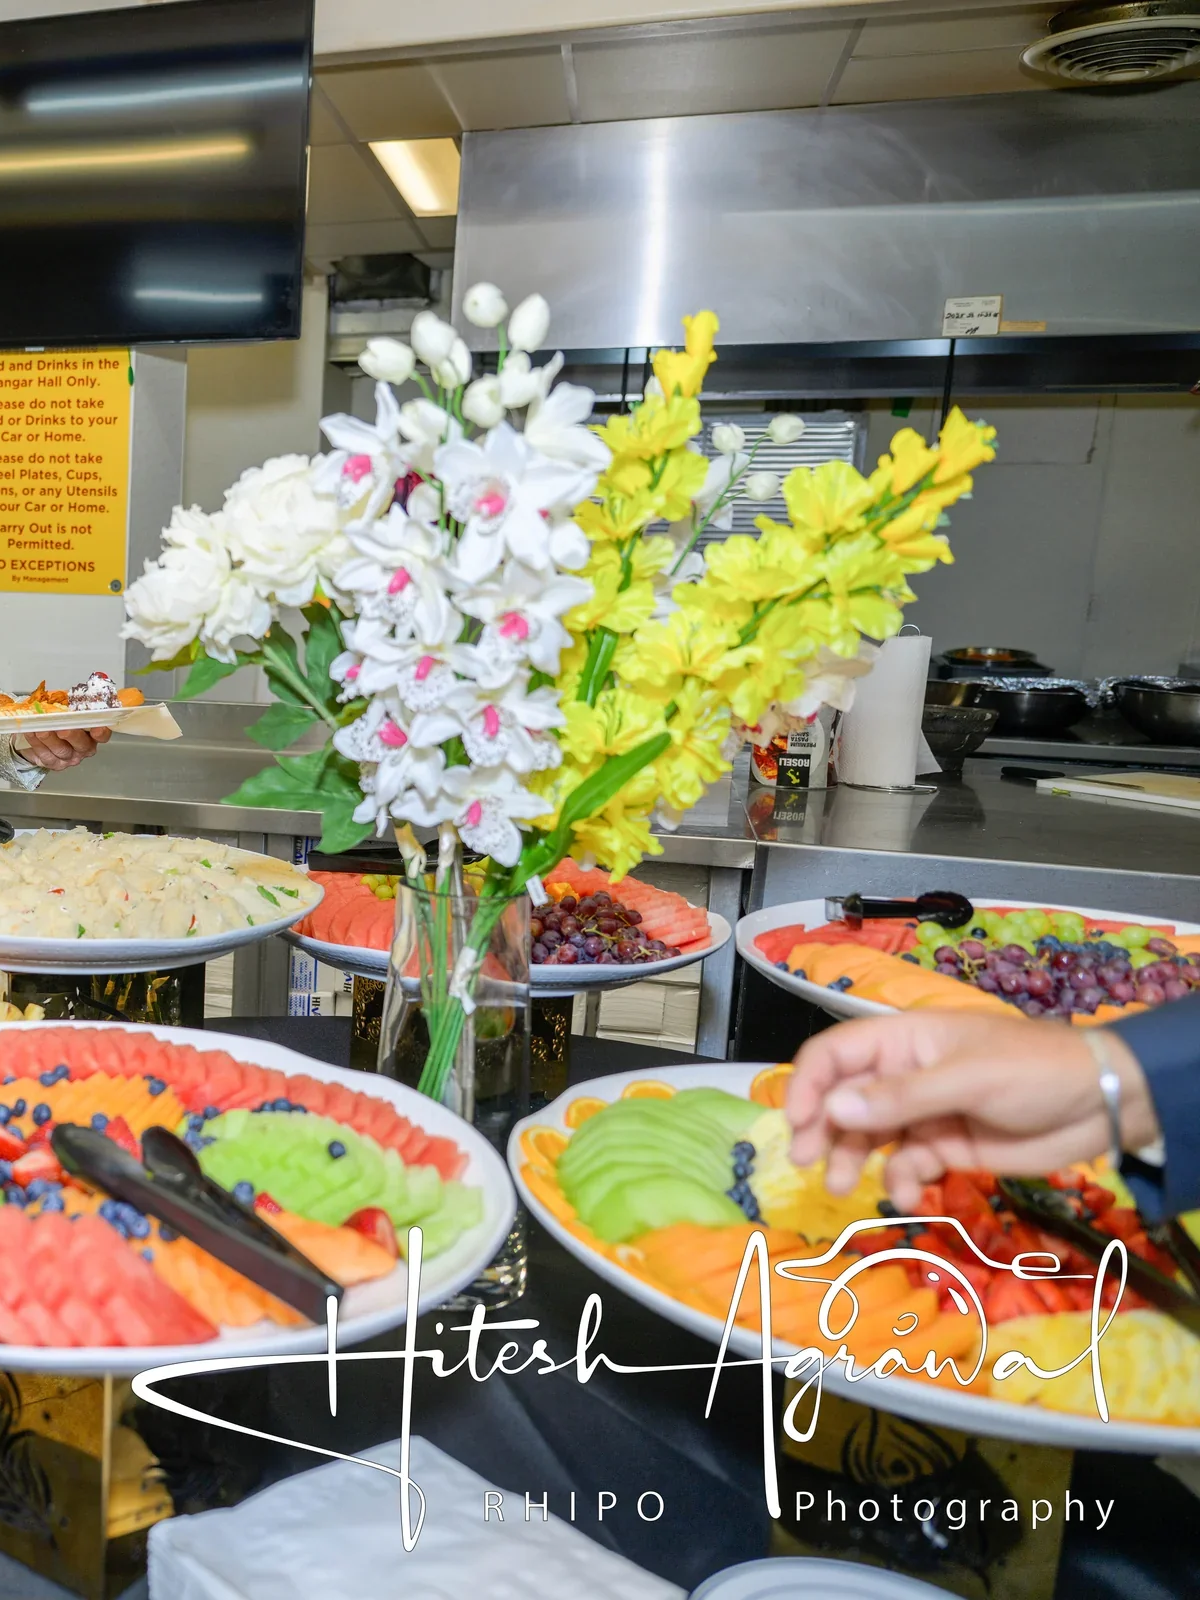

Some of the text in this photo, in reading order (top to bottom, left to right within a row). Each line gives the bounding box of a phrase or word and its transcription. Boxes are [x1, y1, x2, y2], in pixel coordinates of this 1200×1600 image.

[9, 360, 32, 372] and
[37, 360, 77, 371] Drinks
[83, 359, 93, 370] in
[99, 359, 119, 370] the
[38, 376, 61, 387] Hall
[67, 376, 100, 389] Only.
[30, 399, 46, 410] do
[51, 399, 71, 409] not
[76, 398, 104, 409] take
[8, 418, 21, 426] or
[26, 415, 65, 426] Drinks
[71, 416, 83, 426] to
[88, 417, 117, 428] your
[1, 432, 85, 442] Car or Home.
[29, 453, 44, 464] do
[50, 454, 70, 464] not
[75, 453, 102, 464] take
[20, 469, 61, 481] Plates,
[67, 470, 101, 482] Cups,
[22, 488, 35, 496] or
[40, 488, 62, 499] any
[67, 486, 117, 497] Utensils
[25, 502, 46, 513] Car
[51, 504, 63, 513] or
[69, 502, 108, 514] Home.
[29, 523, 52, 534] Out
[57, 524, 66, 535] is
[71, 525, 91, 535] not
[8, 539, 73, 550] Permitted.
[11, 560, 94, 573] EXCEPTIONS
[12, 575, 68, 584] By Management
[779, 757, 810, 767] ROSELI
